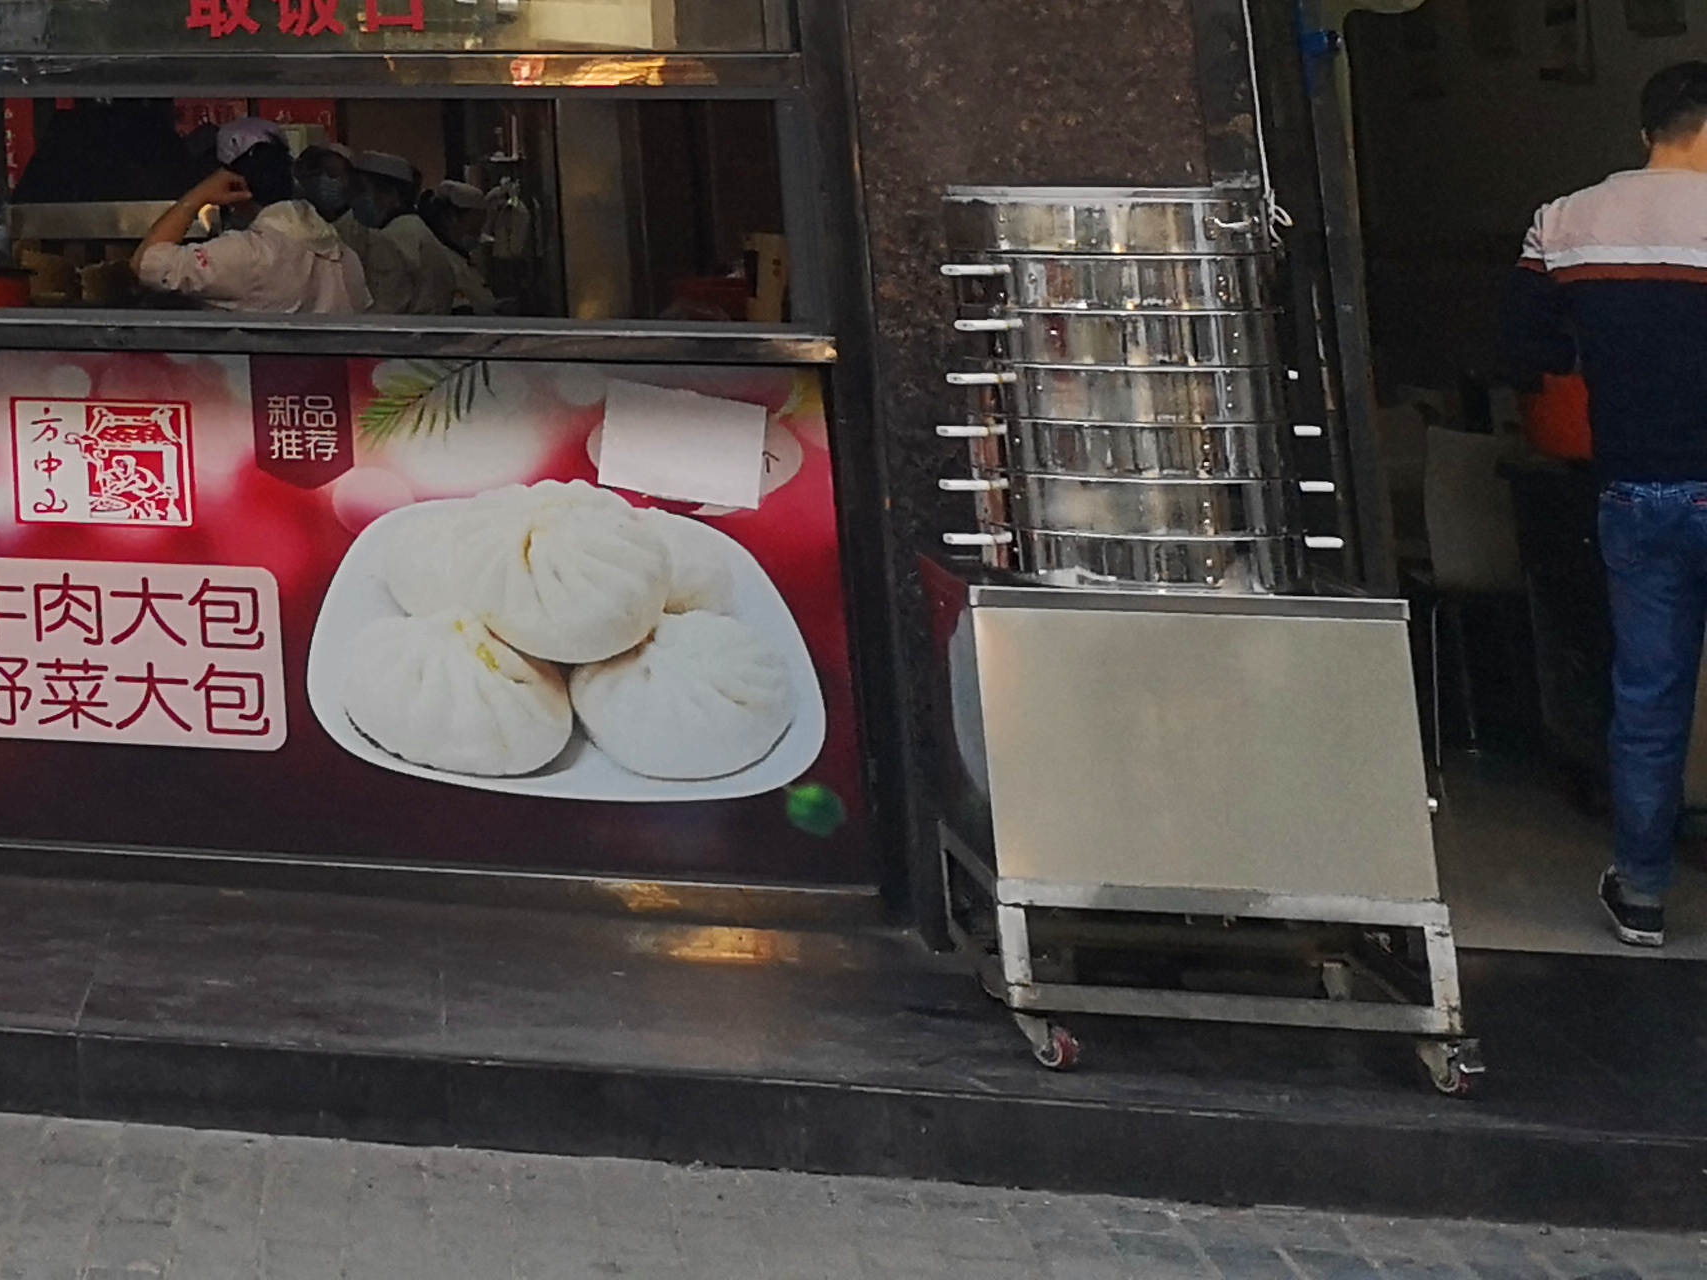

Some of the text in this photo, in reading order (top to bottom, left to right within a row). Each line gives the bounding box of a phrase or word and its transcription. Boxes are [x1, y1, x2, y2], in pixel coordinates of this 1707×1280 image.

[265, 394, 336, 428] 新品
[29, 404, 71, 517] 方中山
[268, 428, 340, 464] 推荐
